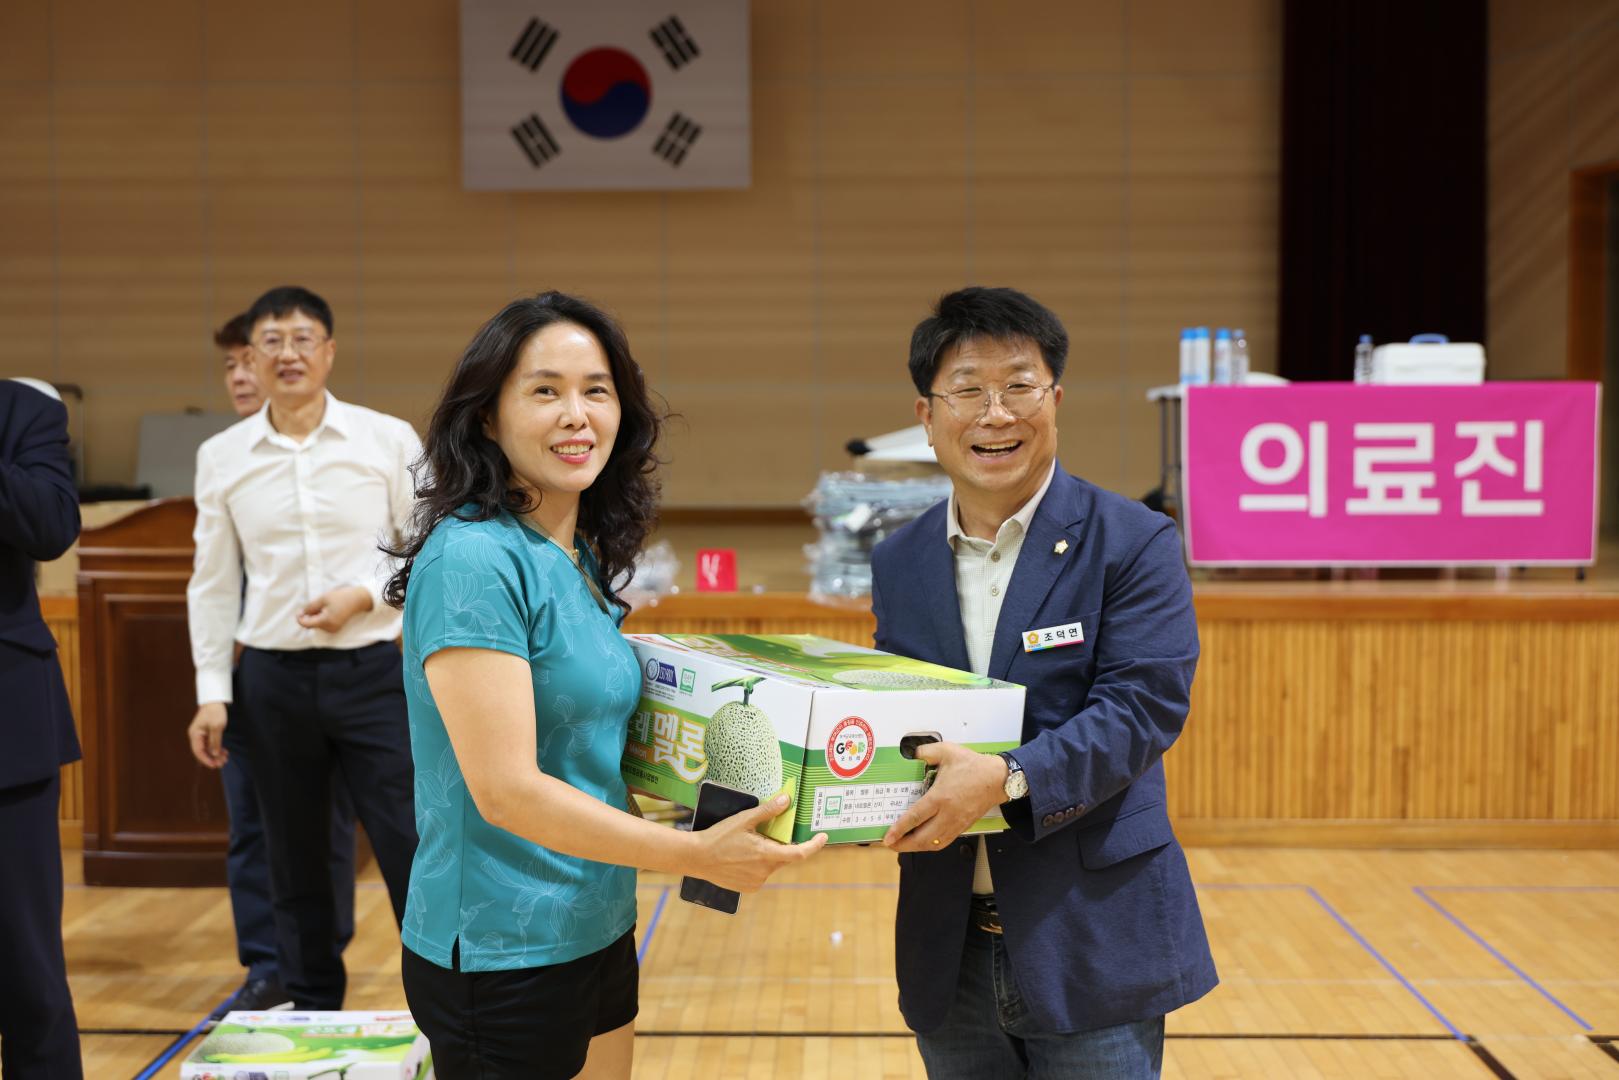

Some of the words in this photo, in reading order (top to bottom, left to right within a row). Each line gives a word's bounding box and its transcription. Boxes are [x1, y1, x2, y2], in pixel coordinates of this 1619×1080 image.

[1238, 420, 1545, 518] 의료진
[1043, 627, 1079, 642] 조덕연
[653, 711, 706, 782] 멜론
